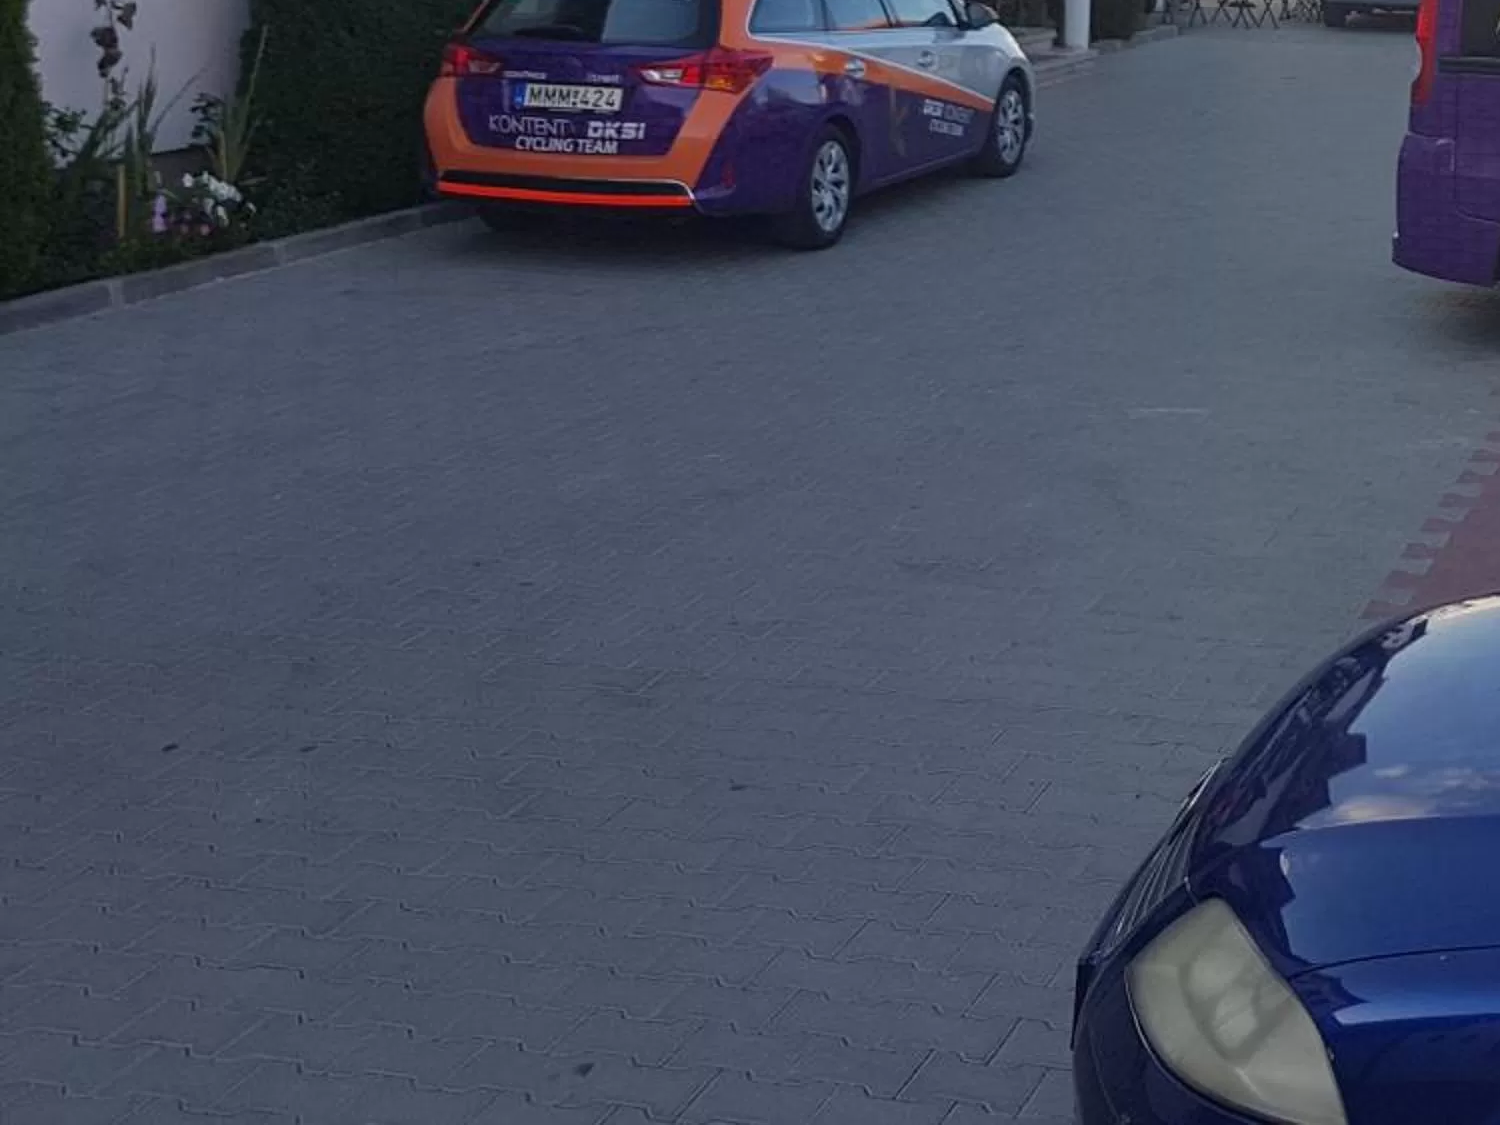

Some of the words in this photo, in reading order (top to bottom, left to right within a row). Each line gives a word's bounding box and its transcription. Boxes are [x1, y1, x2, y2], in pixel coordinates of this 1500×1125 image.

[488, 114, 571, 136] KONTENT
[514, 136, 574, 153] CYCLING
[577, 138, 619, 155] TEAM
